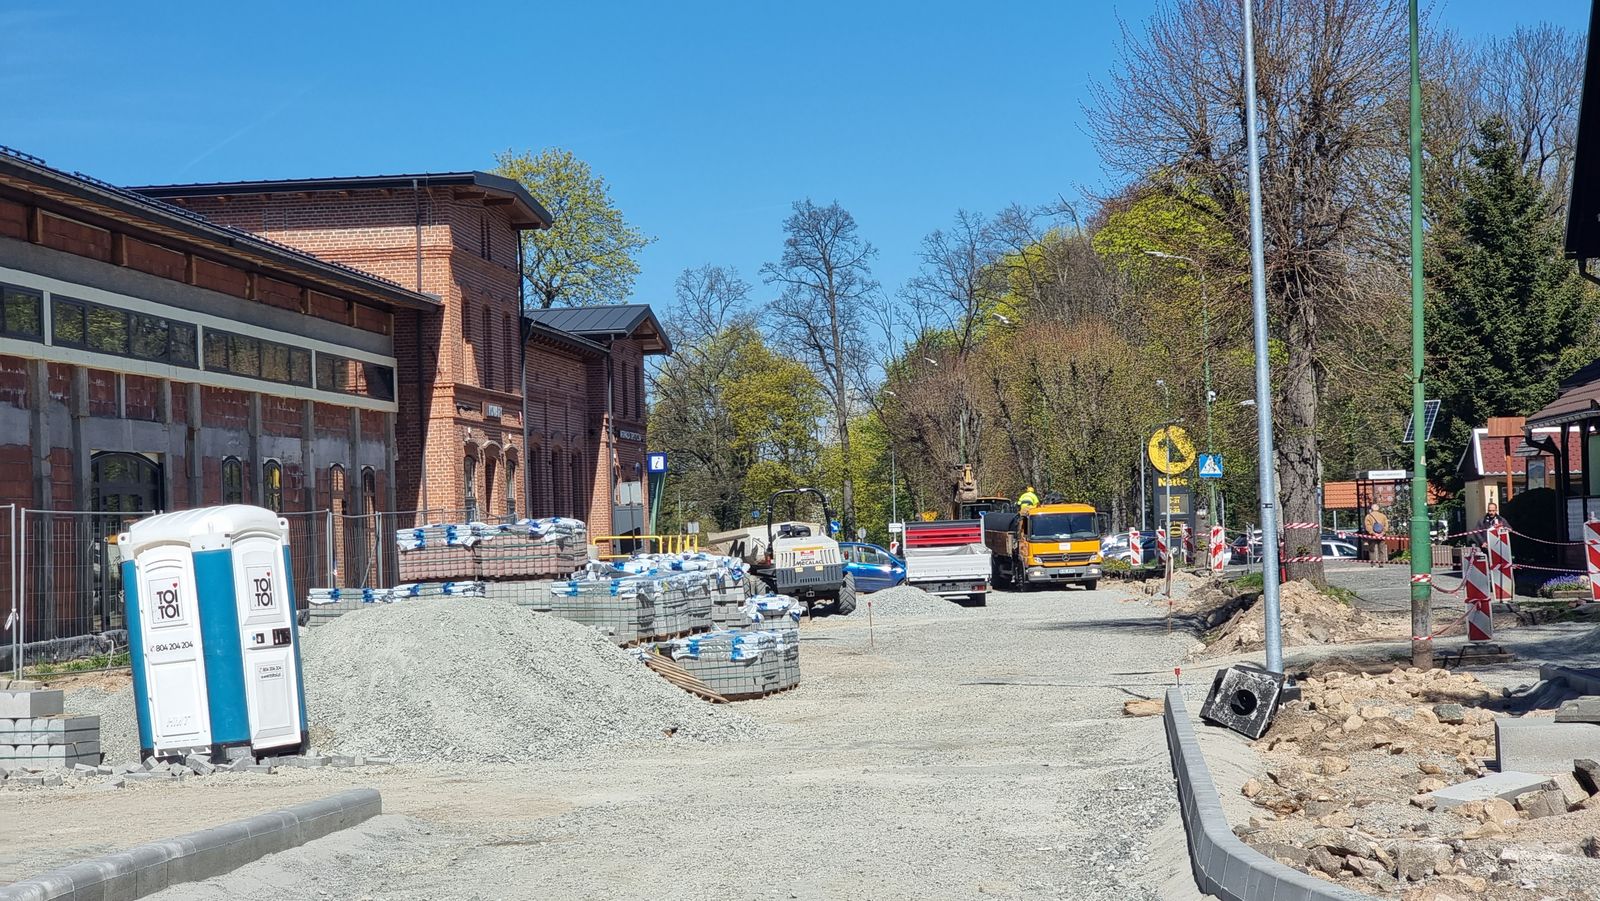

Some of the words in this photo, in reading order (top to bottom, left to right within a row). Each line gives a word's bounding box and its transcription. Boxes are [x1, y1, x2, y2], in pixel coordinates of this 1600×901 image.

[254, 578, 272, 592] TOI
[157, 589, 179, 605] TOI
[255, 593, 273, 607] TOI
[158, 604, 180, 620] TOI
[155, 643, 169, 653] 804
[169, 642, 181, 651] 204
[181, 641, 194, 650] 204
